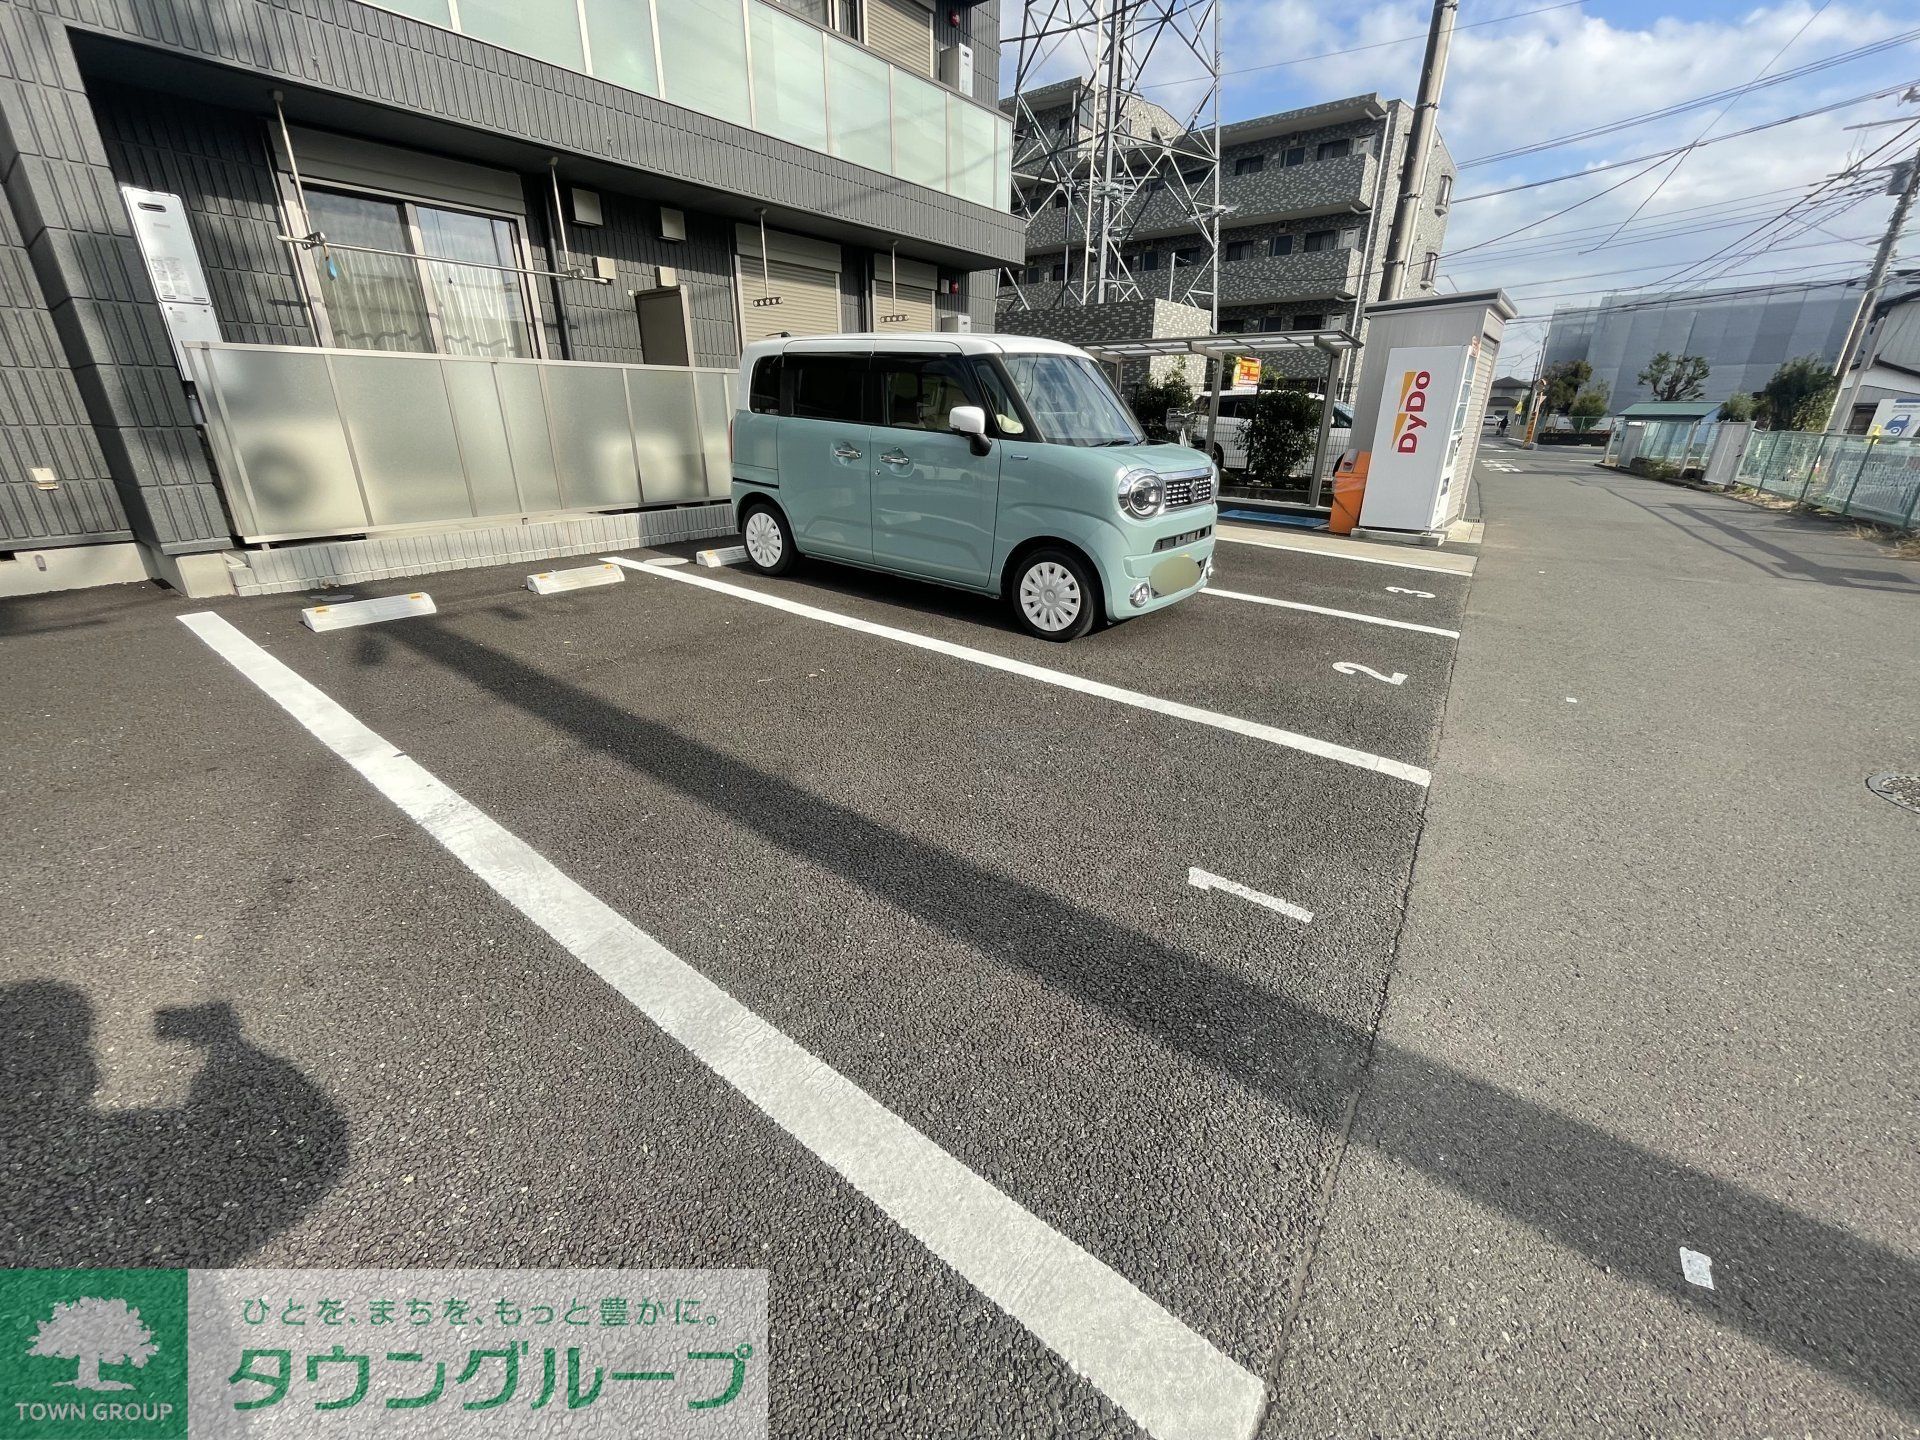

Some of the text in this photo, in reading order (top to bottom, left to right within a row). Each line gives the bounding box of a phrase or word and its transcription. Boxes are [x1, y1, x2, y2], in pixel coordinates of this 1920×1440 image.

[1397, 371, 1431, 453] DyDo
[1384, 586, 1436, 599] 3
[1332, 661, 1408, 686] 2
[1188, 866, 1314, 923] 1
